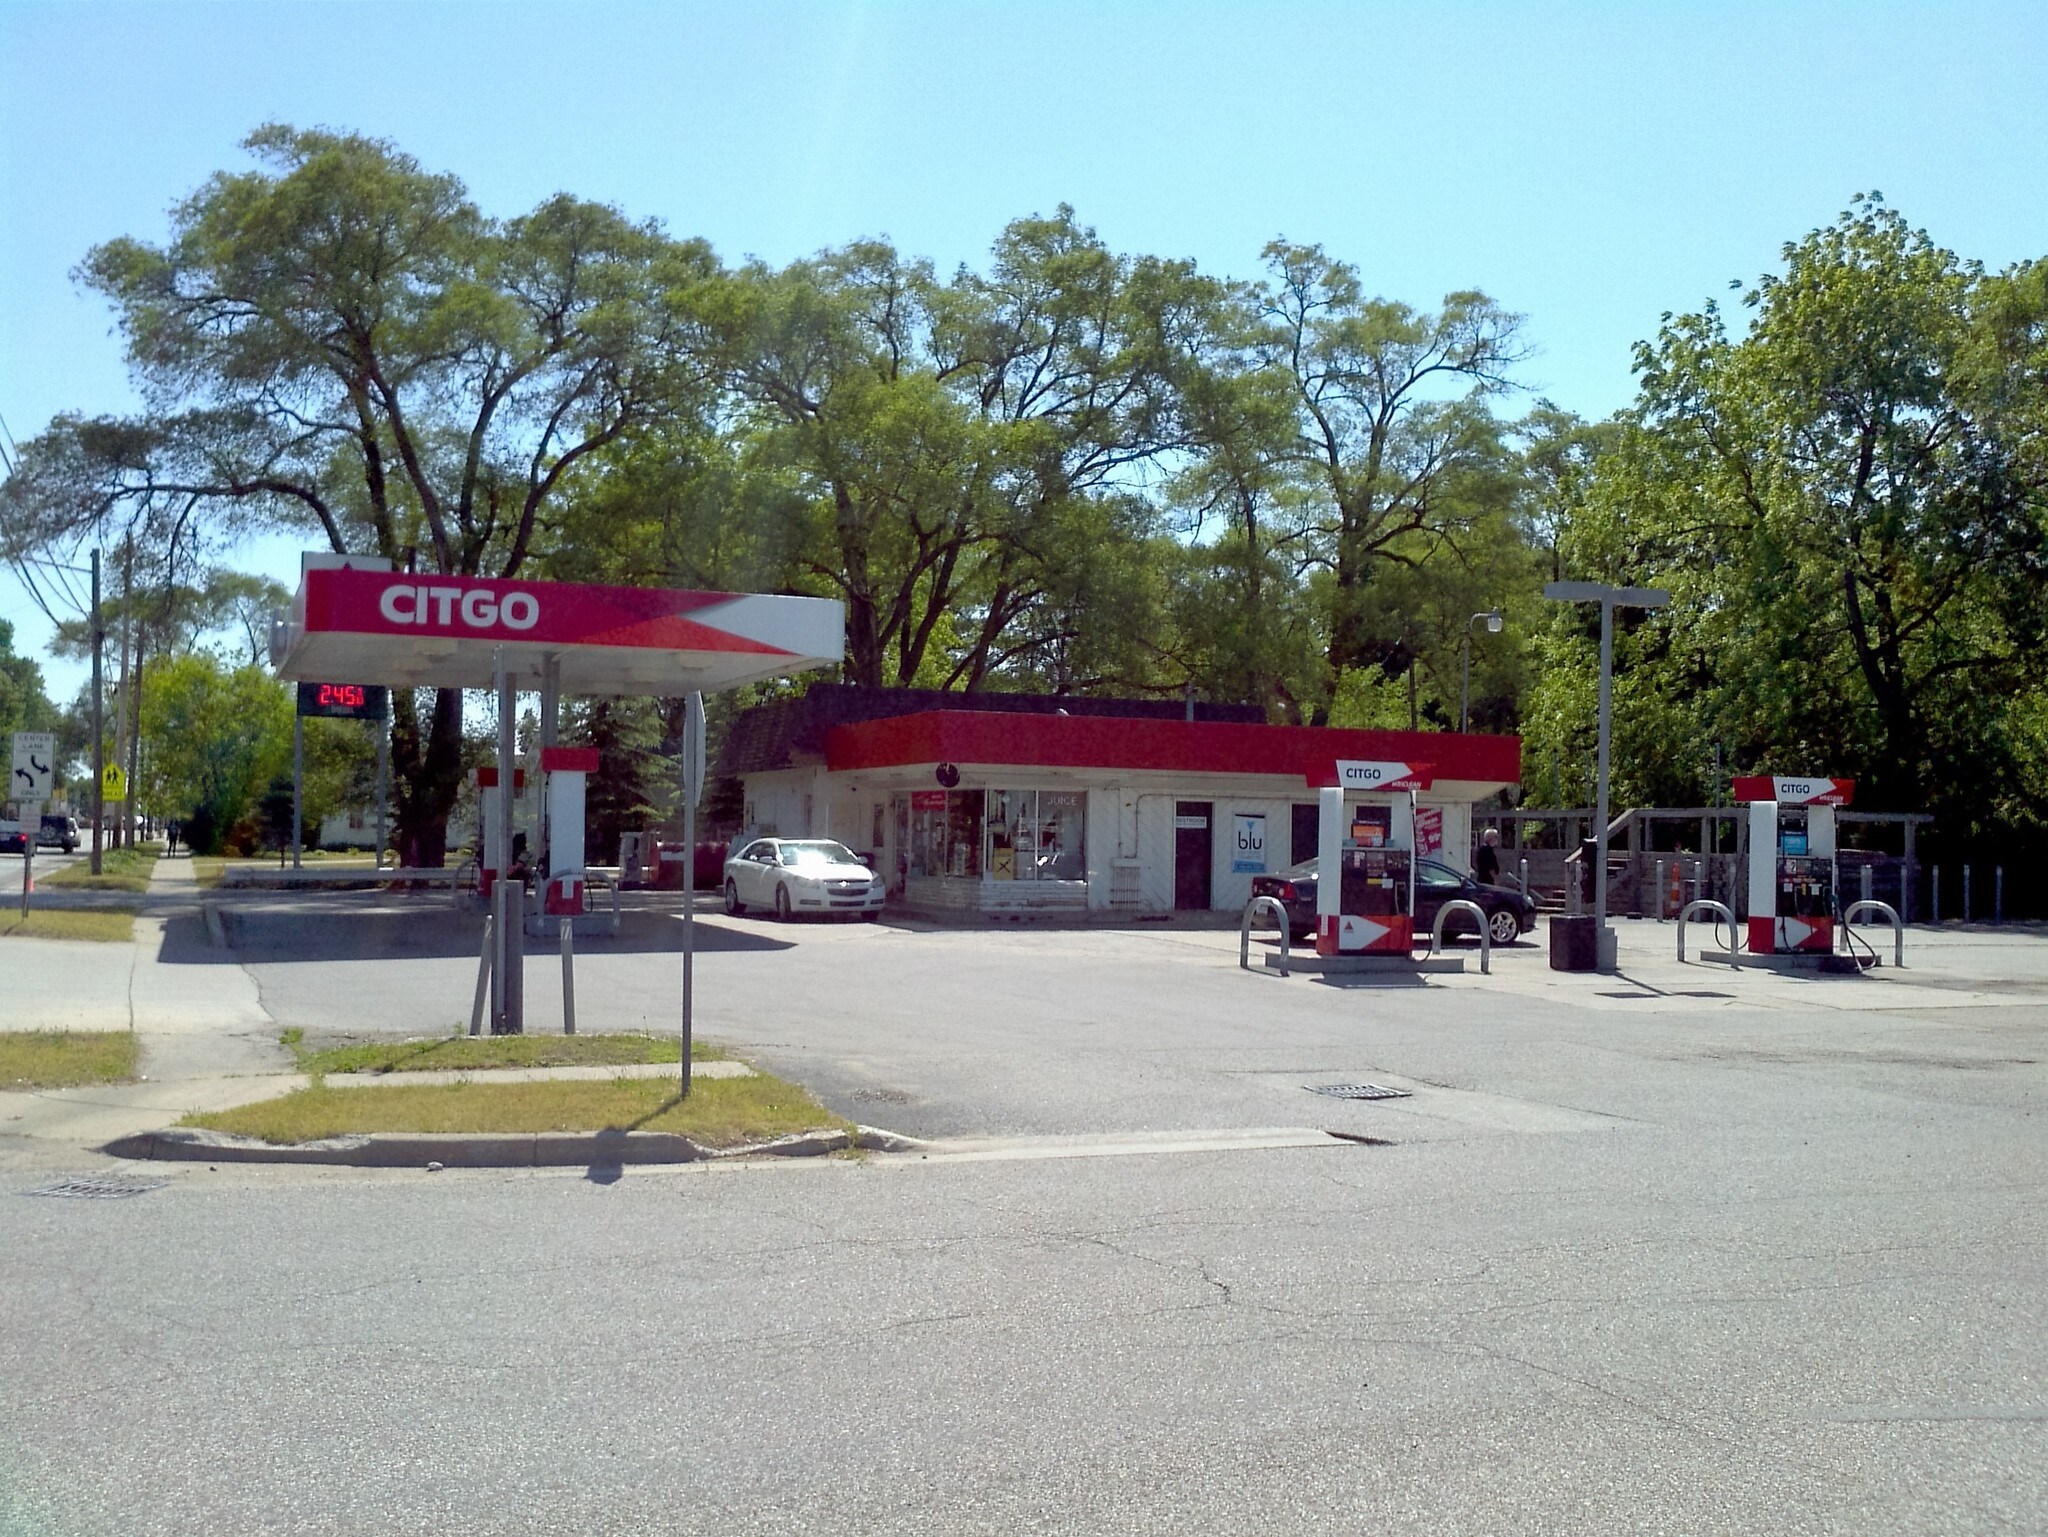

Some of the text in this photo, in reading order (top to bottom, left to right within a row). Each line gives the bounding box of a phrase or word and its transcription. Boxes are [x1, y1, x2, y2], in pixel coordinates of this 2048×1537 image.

[379, 584, 540, 630] CITGO
[1346, 767, 1381, 779] CITGO
[1781, 784, 1810, 794] CITGO
[1047, 796, 1077, 806] JUICE
[1237, 830, 1262, 850] blu
[1790, 861, 1795, 872] 2
